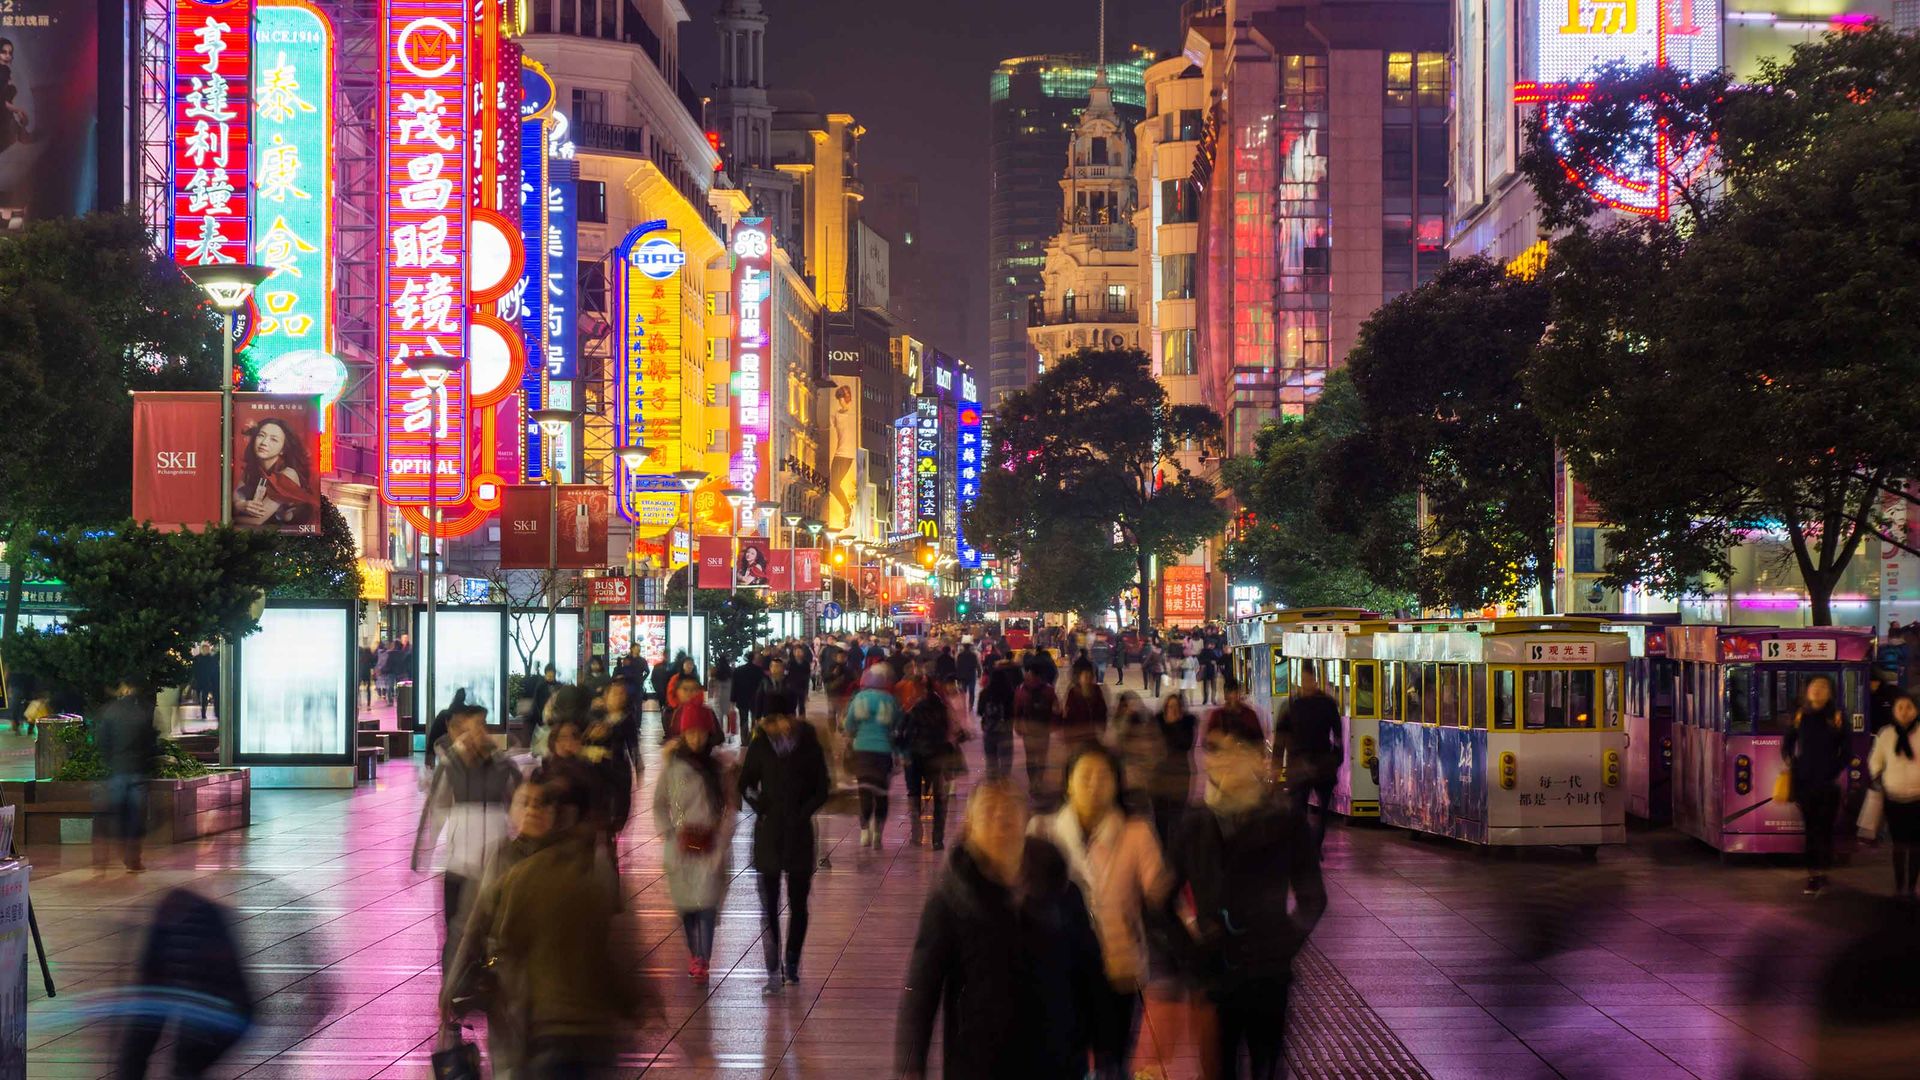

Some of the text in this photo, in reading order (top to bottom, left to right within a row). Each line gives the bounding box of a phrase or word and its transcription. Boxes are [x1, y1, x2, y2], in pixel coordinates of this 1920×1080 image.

[256, 51, 318, 336] 泰康食品
[634, 253, 685, 264] BAC
[742, 434, 757, 462] First
[157, 451, 197, 468] SK-II
[513, 520, 537, 531] SK-II
[595, 581, 614, 590] BUS
[1549, 645, 1588, 656] 观光车
[1786, 642, 1828, 652] 观光车
[1611, 713, 1618, 727] 2
[1854, 716, 1863, 730] 10
[1538, 775, 1582, 789] 每一代
[1519, 791, 1607, 806] 都是一个时代
